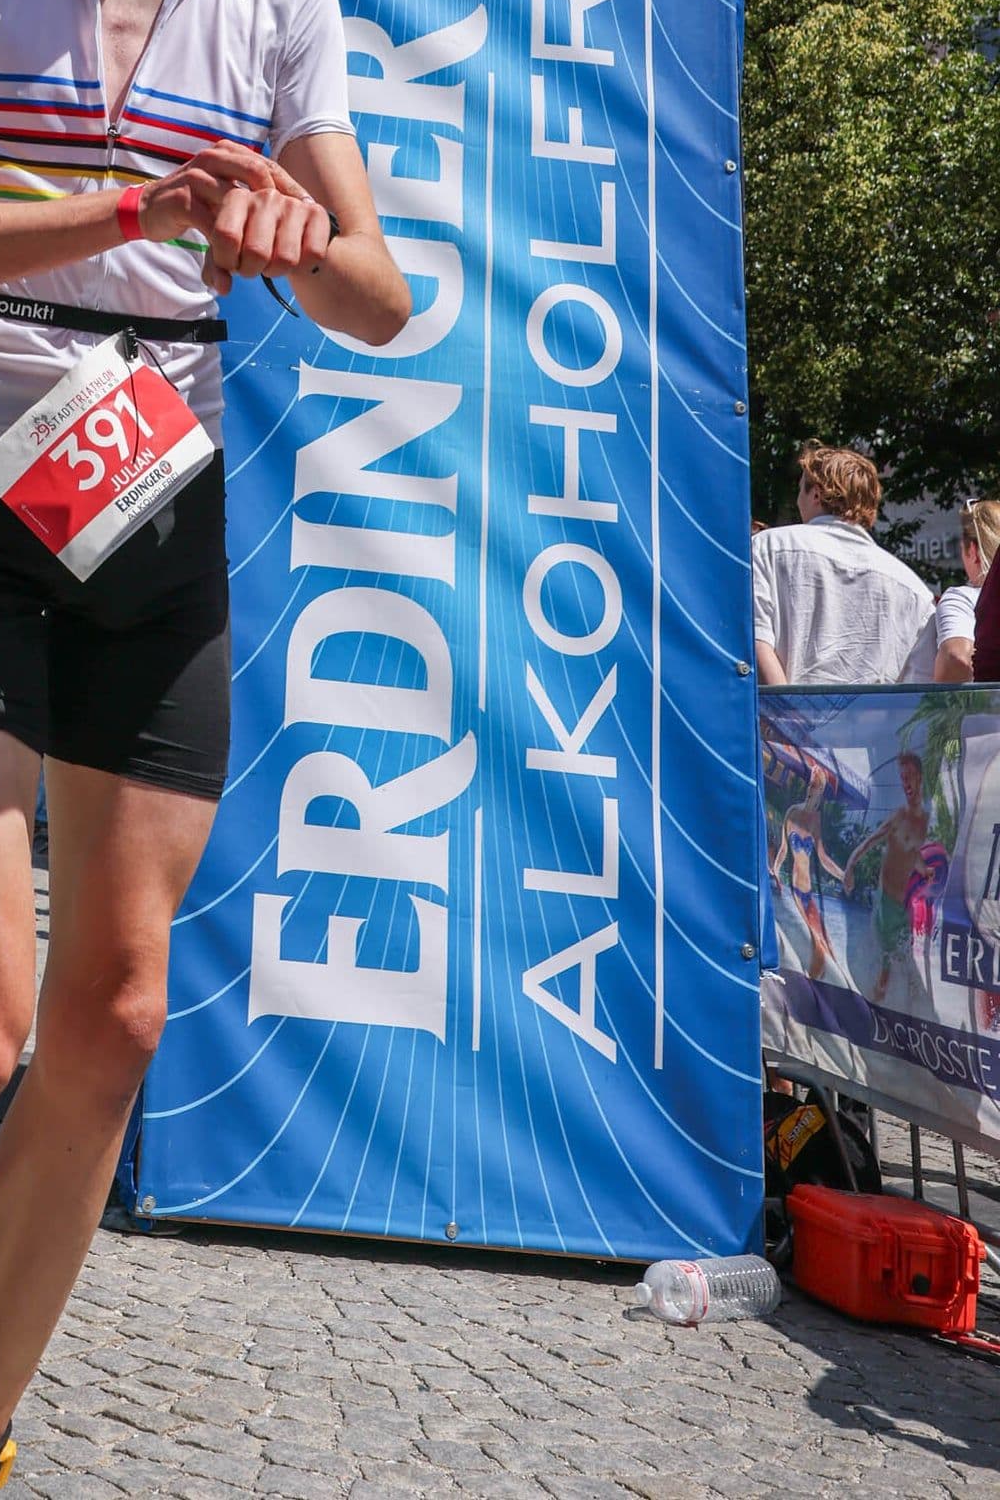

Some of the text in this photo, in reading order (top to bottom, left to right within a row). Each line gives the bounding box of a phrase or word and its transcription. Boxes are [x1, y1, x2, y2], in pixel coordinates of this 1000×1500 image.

[49, 388, 154, 491] 391
[111, 447, 156, 492] JULIAN
[115, 468, 165, 513] ERDINGER
[248, 3, 489, 1046] ERDINGER
